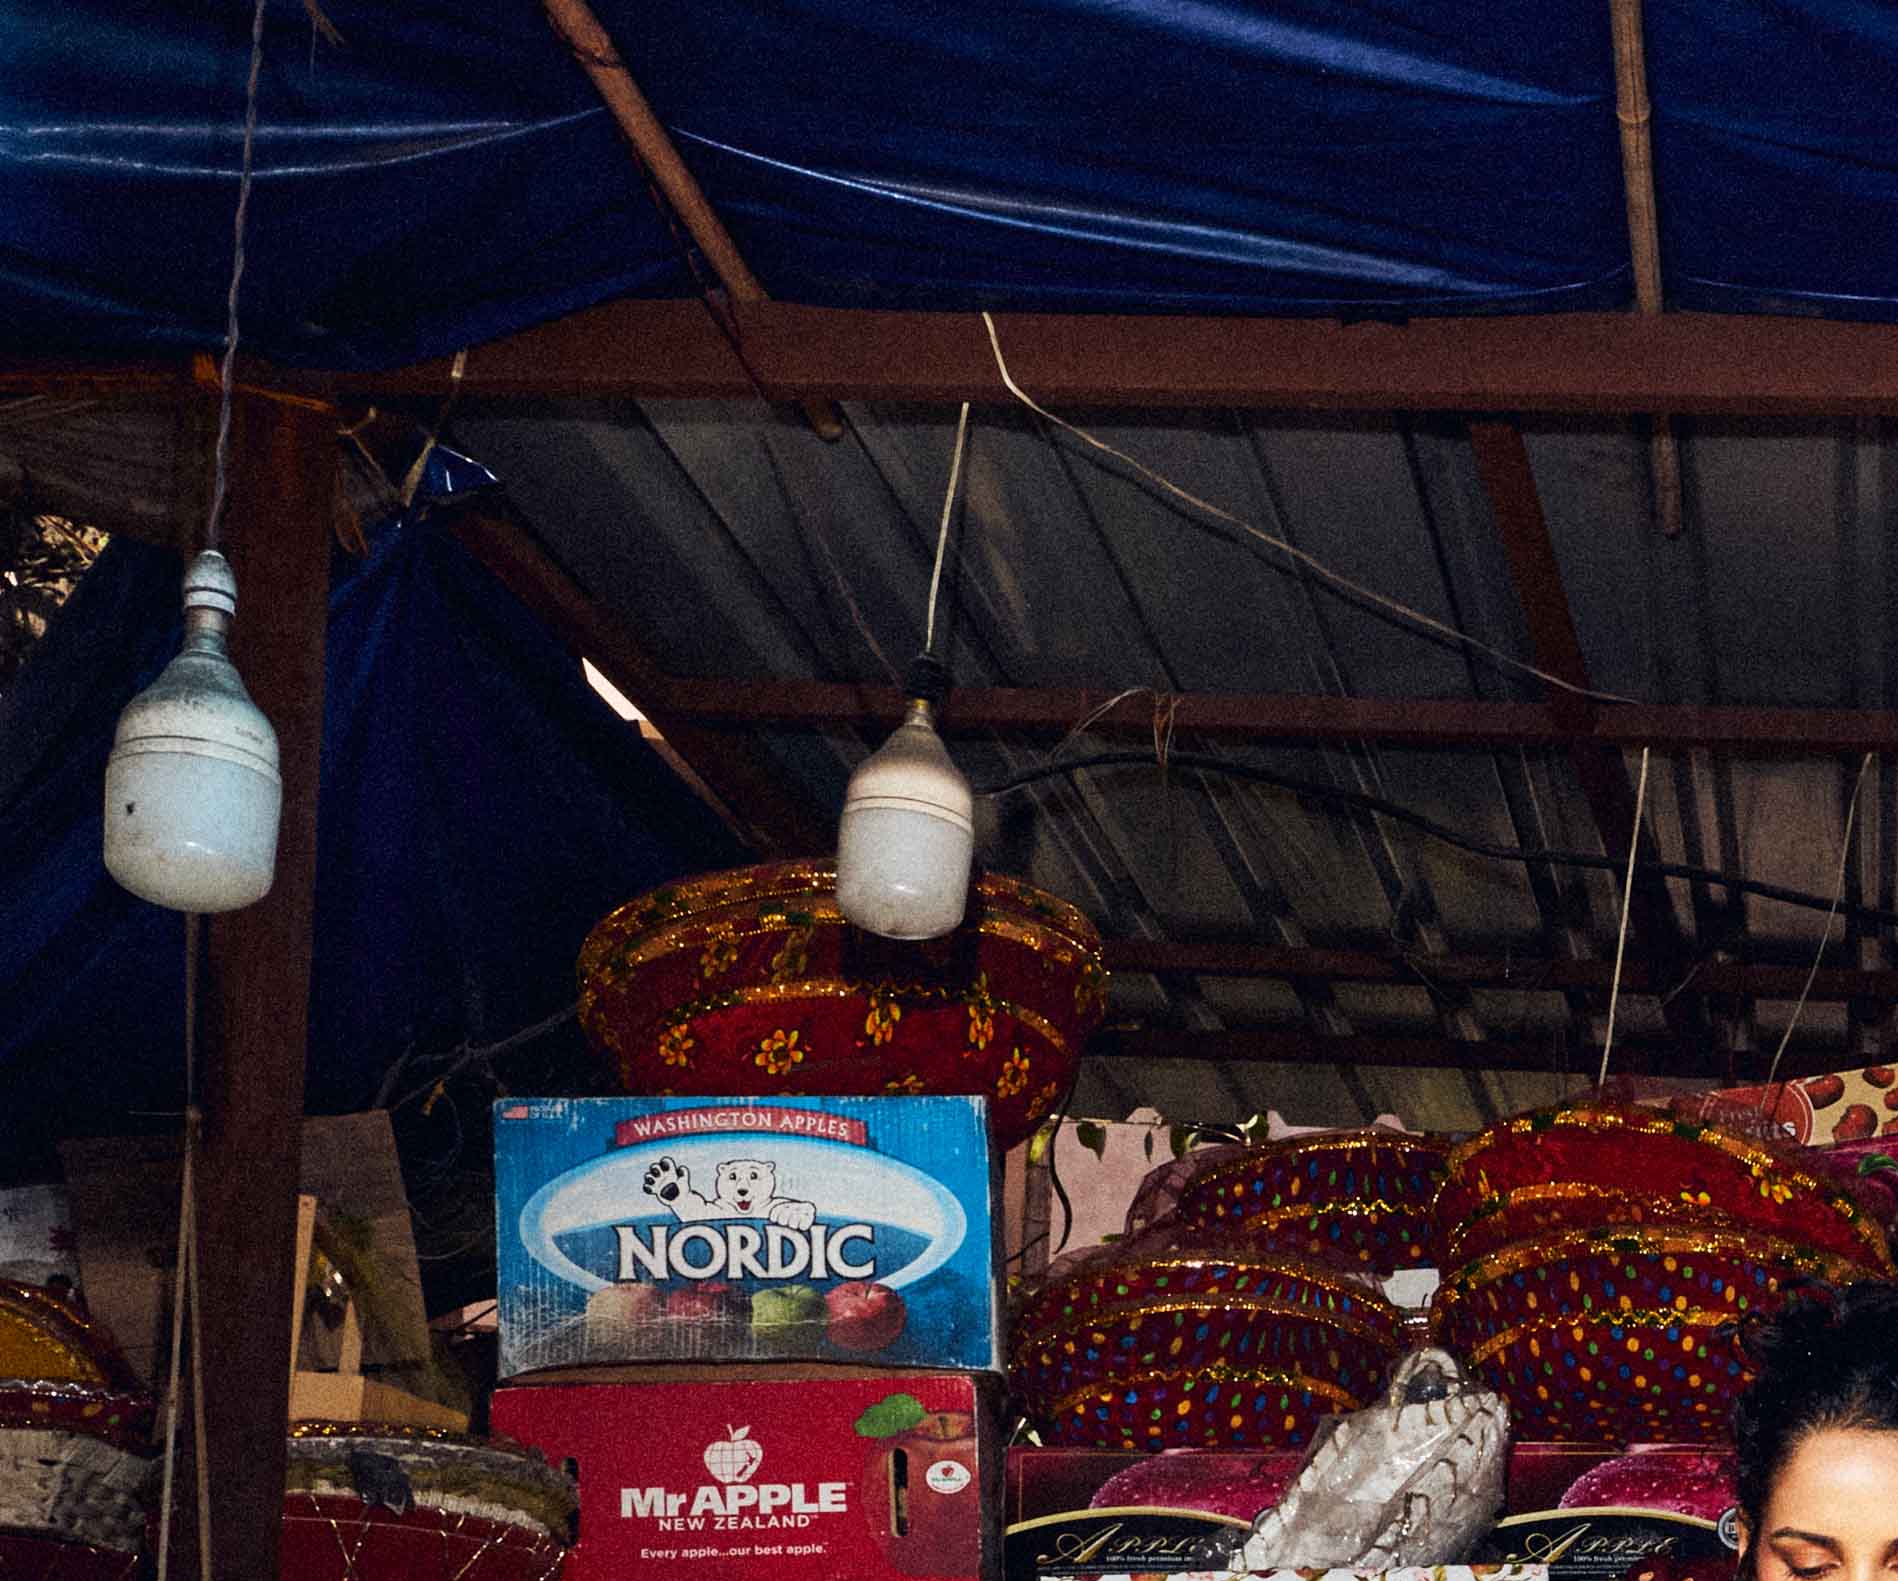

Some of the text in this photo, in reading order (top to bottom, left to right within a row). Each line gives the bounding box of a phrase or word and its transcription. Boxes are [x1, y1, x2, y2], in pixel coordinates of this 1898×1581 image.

[633, 1112, 849, 1138] WASHINGTON APPLES
[616, 1224, 876, 1281] NORDIC
[620, 1482, 847, 1518] Mr APPLE
[658, 1515, 810, 1532] NEW ZEALAND
[640, 1547, 678, 1559] Every
[754, 1543, 783, 1555] best
[785, 1543, 827, 1555] apple.
[1506, 1523, 1679, 1563] APPLE
